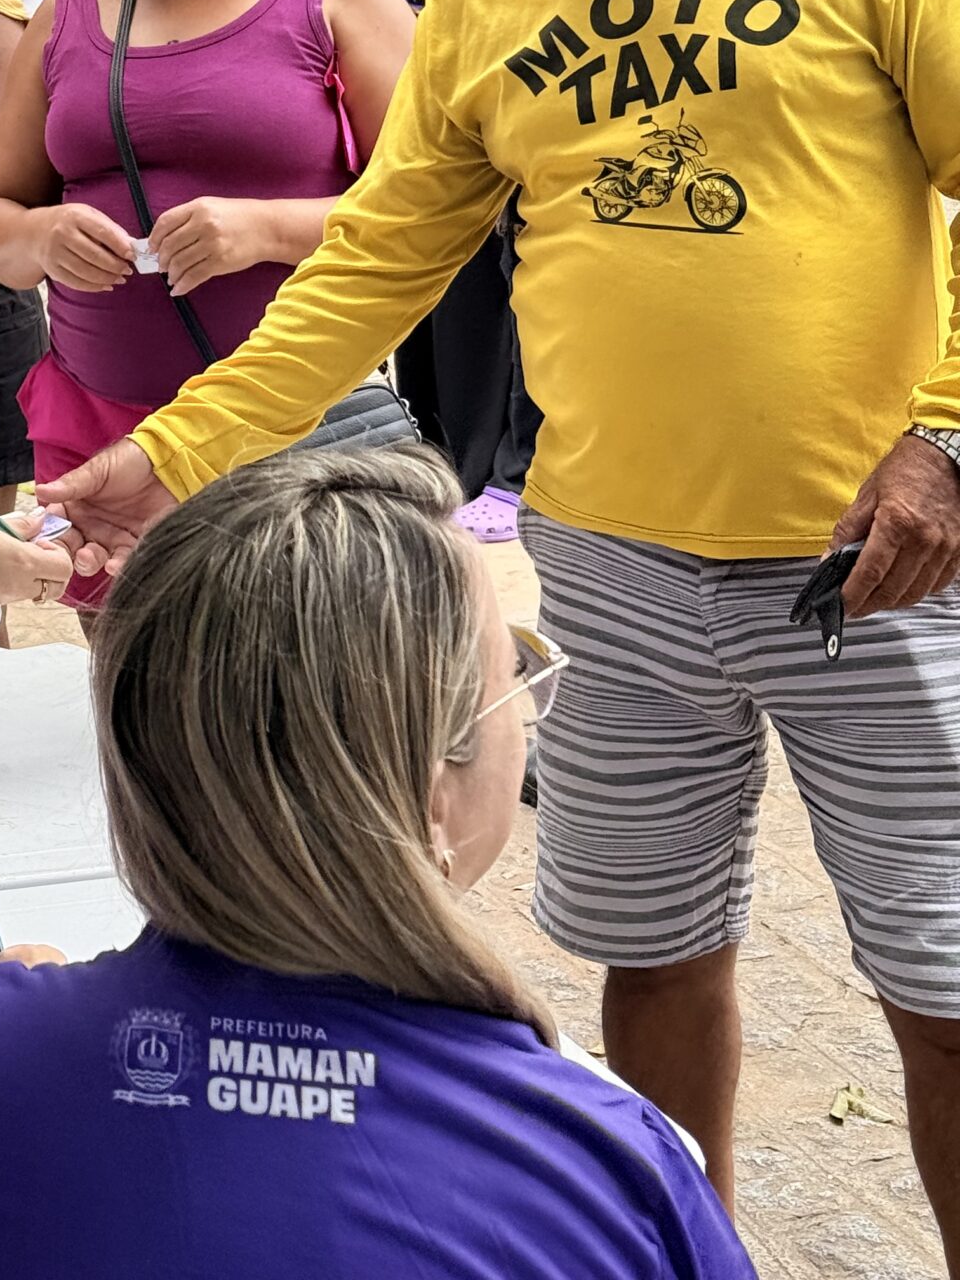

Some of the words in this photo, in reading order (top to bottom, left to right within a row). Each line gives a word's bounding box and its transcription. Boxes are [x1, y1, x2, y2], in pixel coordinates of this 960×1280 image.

[559, 33, 737, 125] TAXI
[210, 1017, 327, 1041] PREFEITURA
[208, 1038, 375, 1087] MAMAN
[207, 1076, 355, 1124] GUAPE
